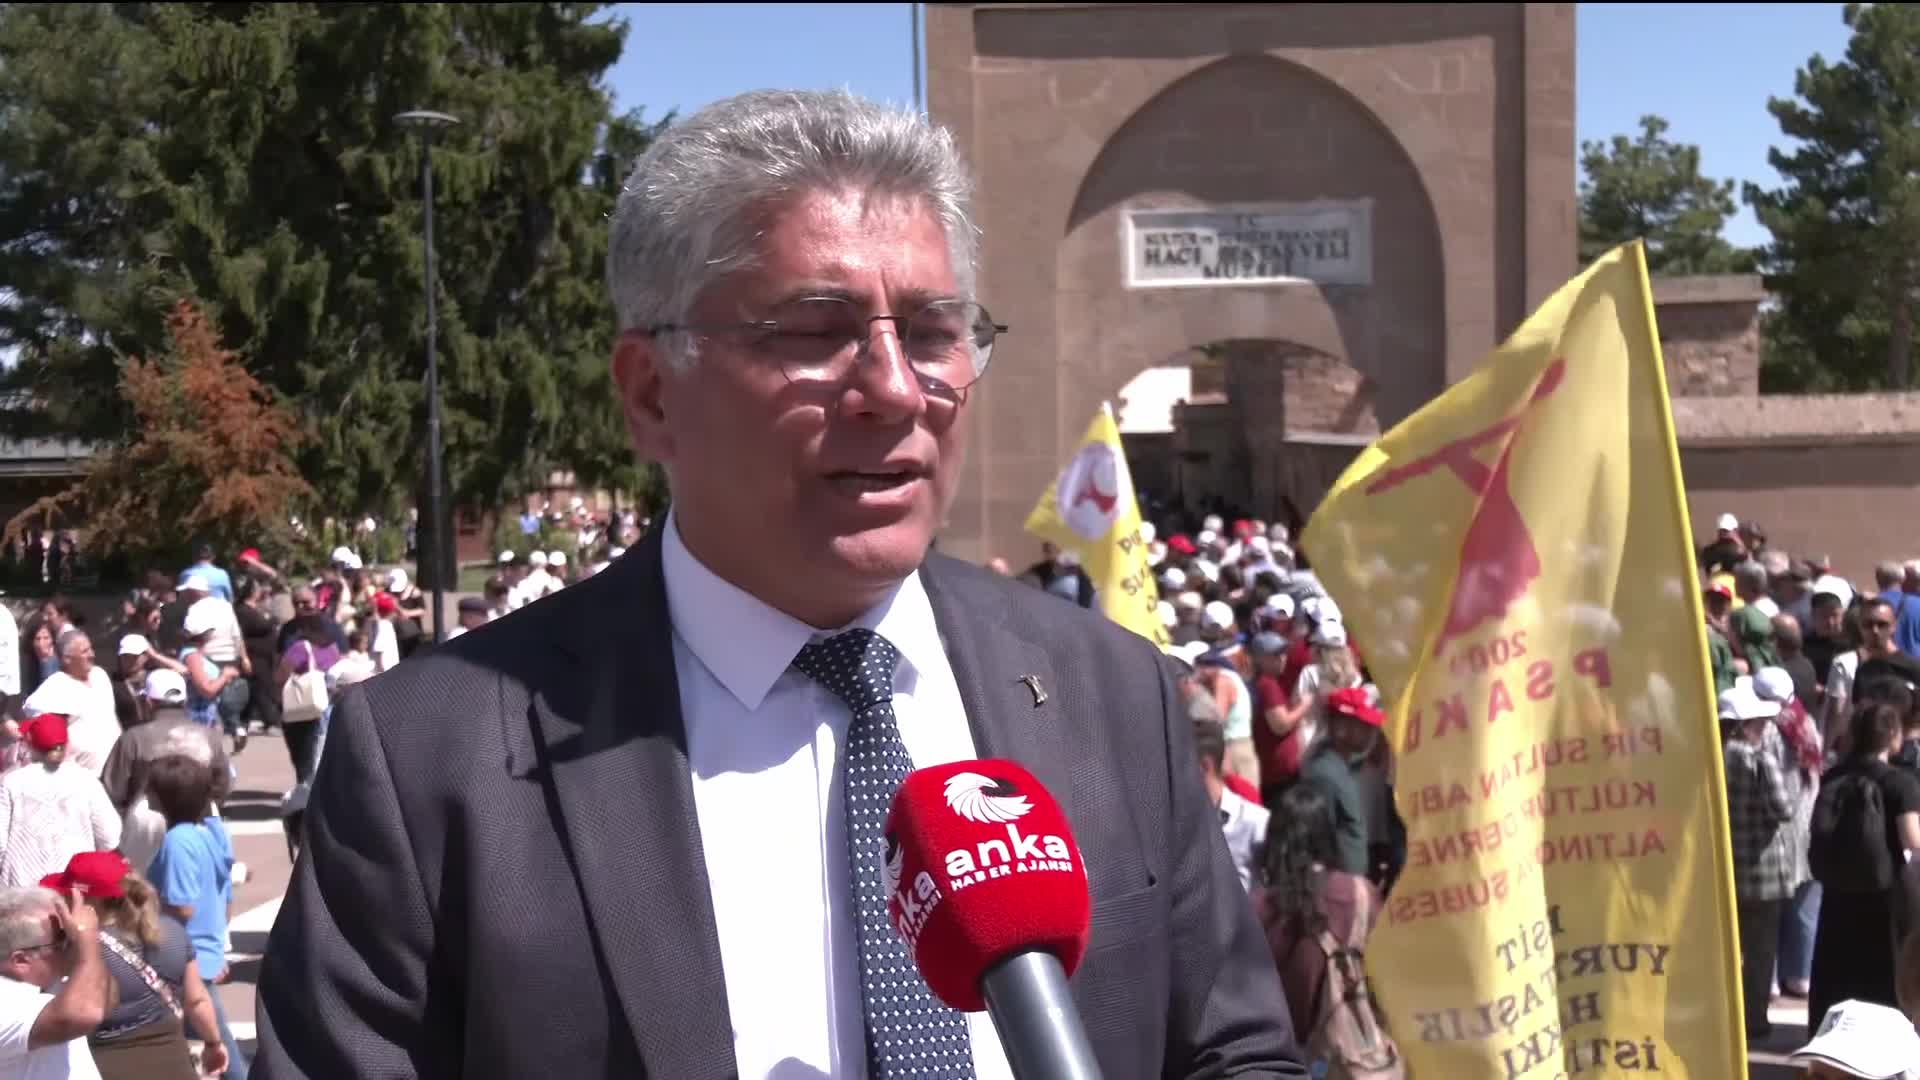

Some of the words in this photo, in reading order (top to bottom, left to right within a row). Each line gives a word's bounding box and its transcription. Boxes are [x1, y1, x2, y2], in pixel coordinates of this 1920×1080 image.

[945, 823, 1070, 877] anka
[950, 864, 1011, 891] HABER
[1016, 859, 1073, 874] AJANSI
